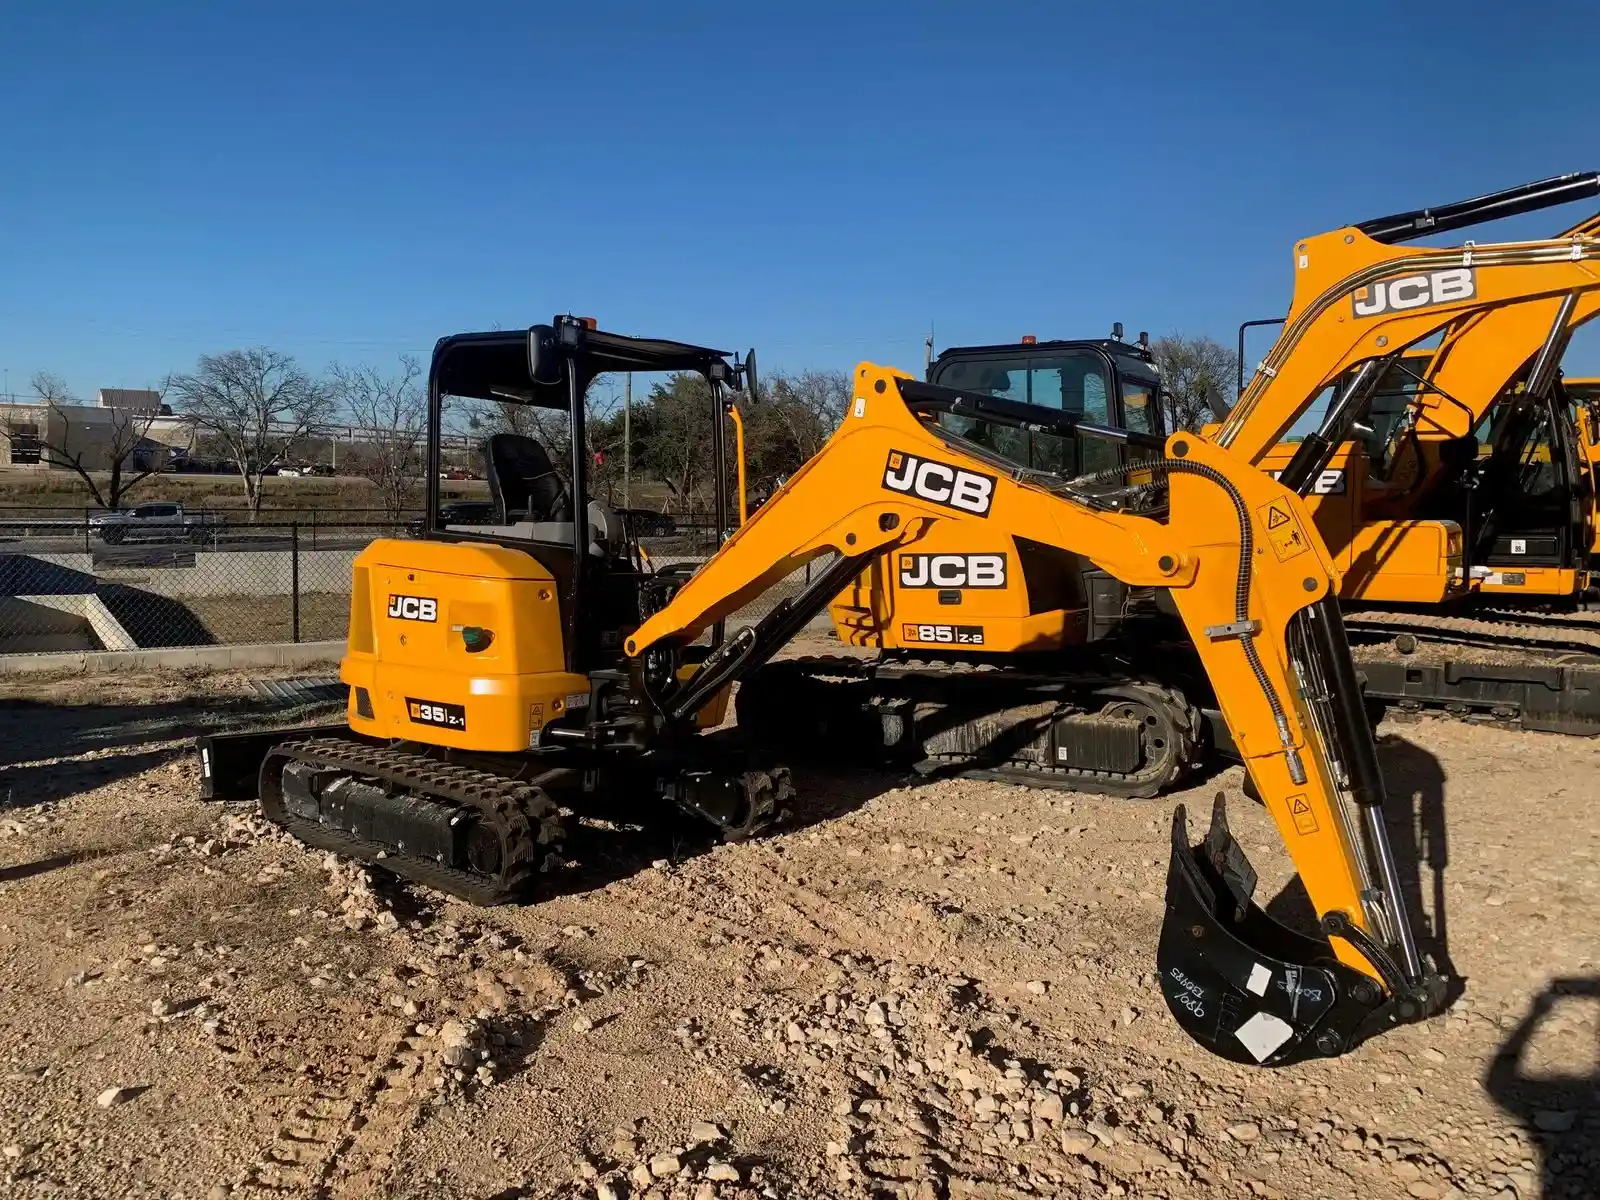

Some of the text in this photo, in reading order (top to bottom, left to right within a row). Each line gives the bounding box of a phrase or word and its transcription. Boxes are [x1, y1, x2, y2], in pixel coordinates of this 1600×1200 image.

[1355, 269, 1474, 316] JCB
[886, 458, 993, 513] JCB
[902, 556, 1005, 587] JCB
[390, 597, 436, 621] JCB
[918, 625, 984, 644] 85 Z-2
[420, 704, 465, 727] 35 Z-1
